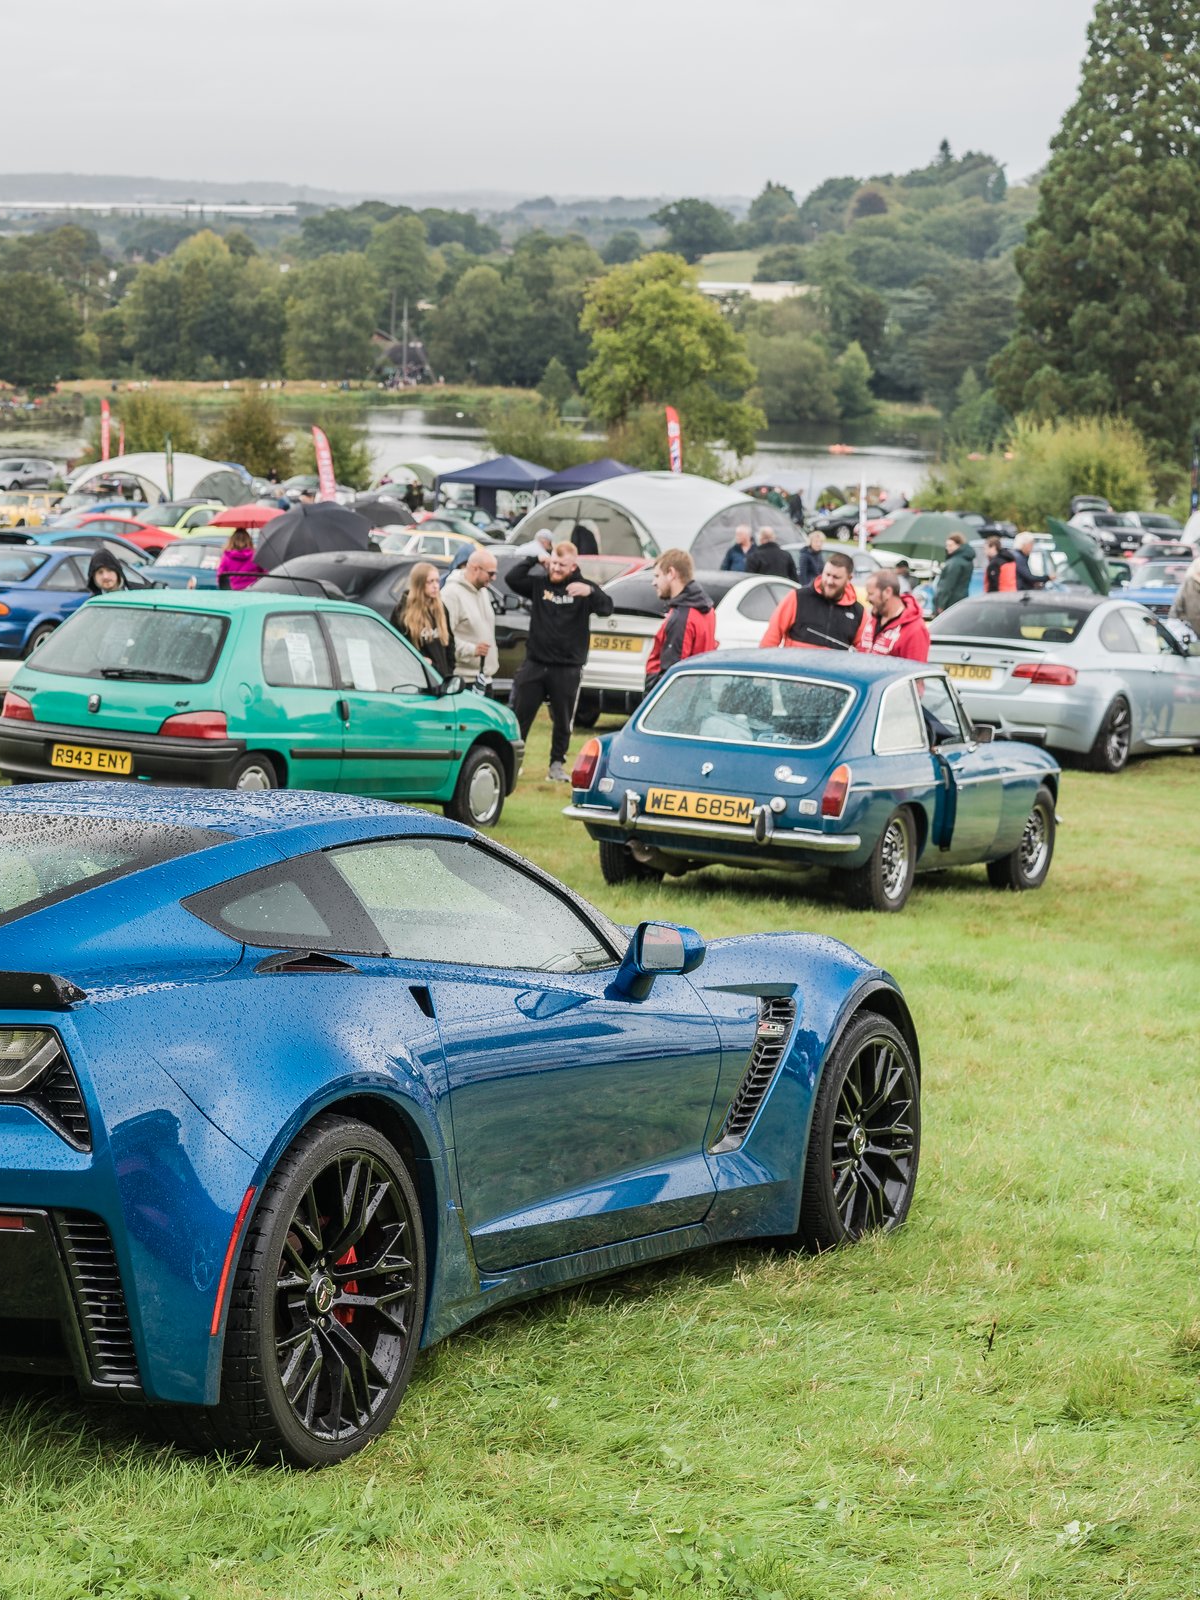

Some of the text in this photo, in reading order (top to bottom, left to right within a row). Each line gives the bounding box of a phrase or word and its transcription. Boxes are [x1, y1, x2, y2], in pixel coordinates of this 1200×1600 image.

[593, 637, 632, 650] S19 SYE
[55, 748, 128, 770] R943 ENY
[623, 755, 640, 764] V8
[651, 792, 750, 820] WEA 685M
